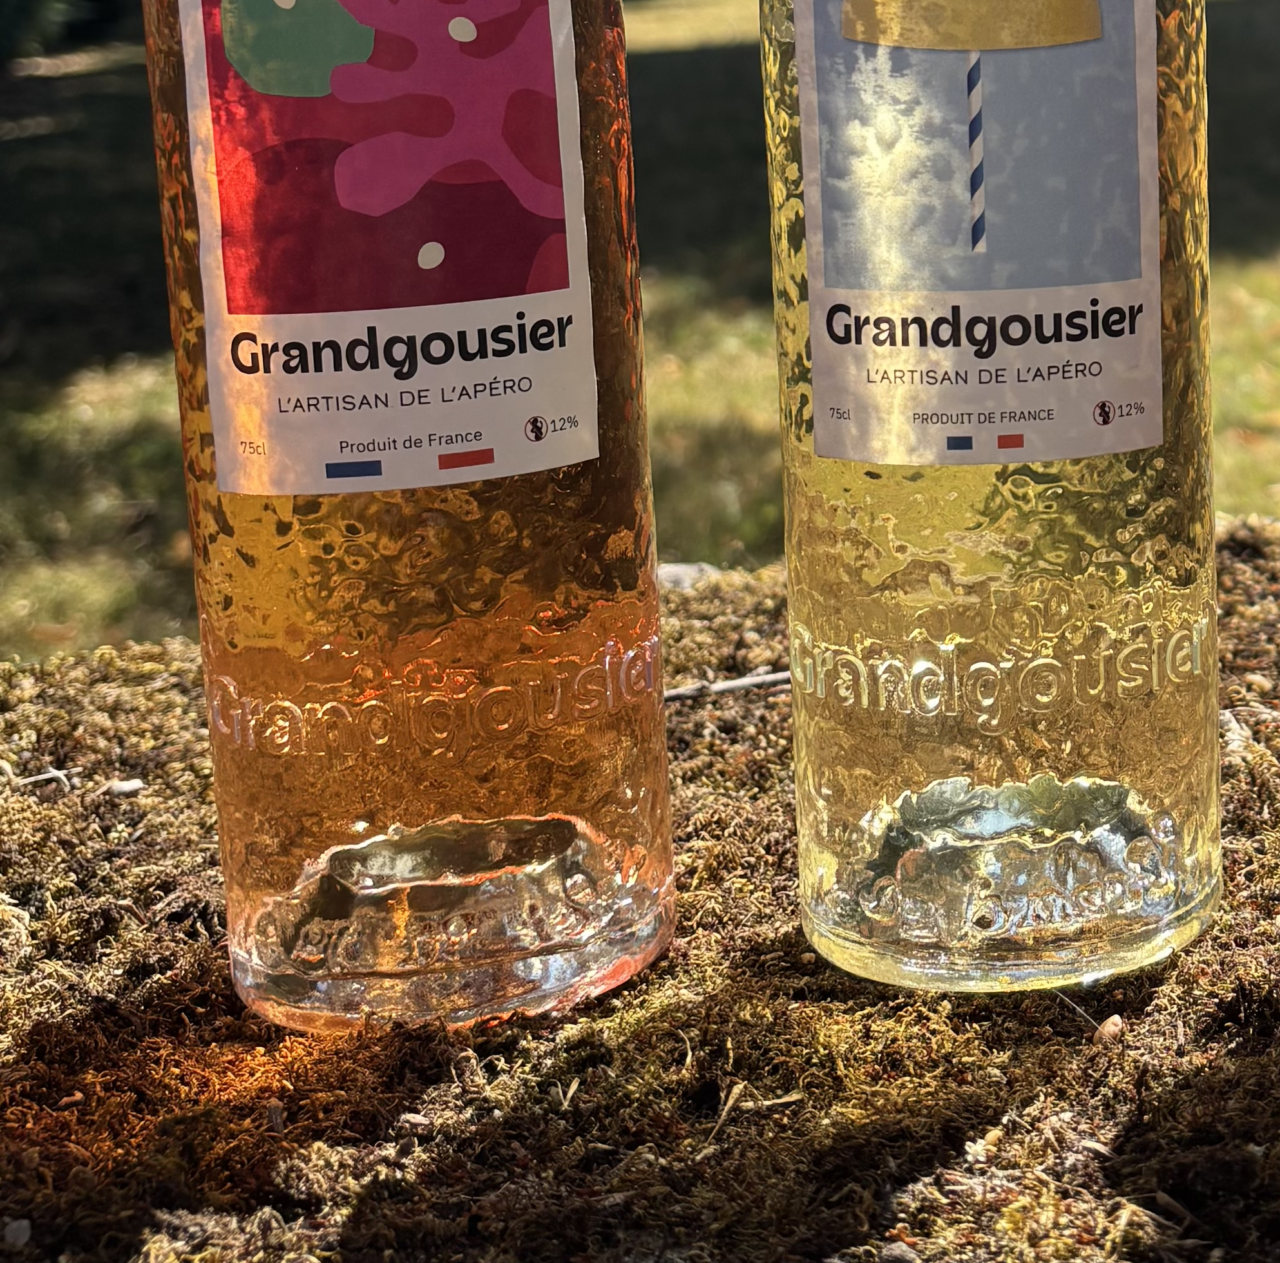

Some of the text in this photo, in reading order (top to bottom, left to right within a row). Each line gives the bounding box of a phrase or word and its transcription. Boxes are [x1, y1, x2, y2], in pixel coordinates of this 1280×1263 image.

[826, 298, 1143, 359] Grandgousier
[230, 311, 573, 380] Grandgousier
[867, 360, 1102, 385] L'ARTISAN DE L'APÉRO
[278, 376, 533, 413] L'ARTISAN DE L'APÉRO
[829, 407, 851, 421] 75cl
[912, 409, 1055, 425] PRODUIT DE FRANCE
[1117, 401, 1145, 418] 12%
[550, 415, 579, 433] 12%
[240, 440, 266, 456] 75cl
[339, 430, 483, 454] Produit de France
